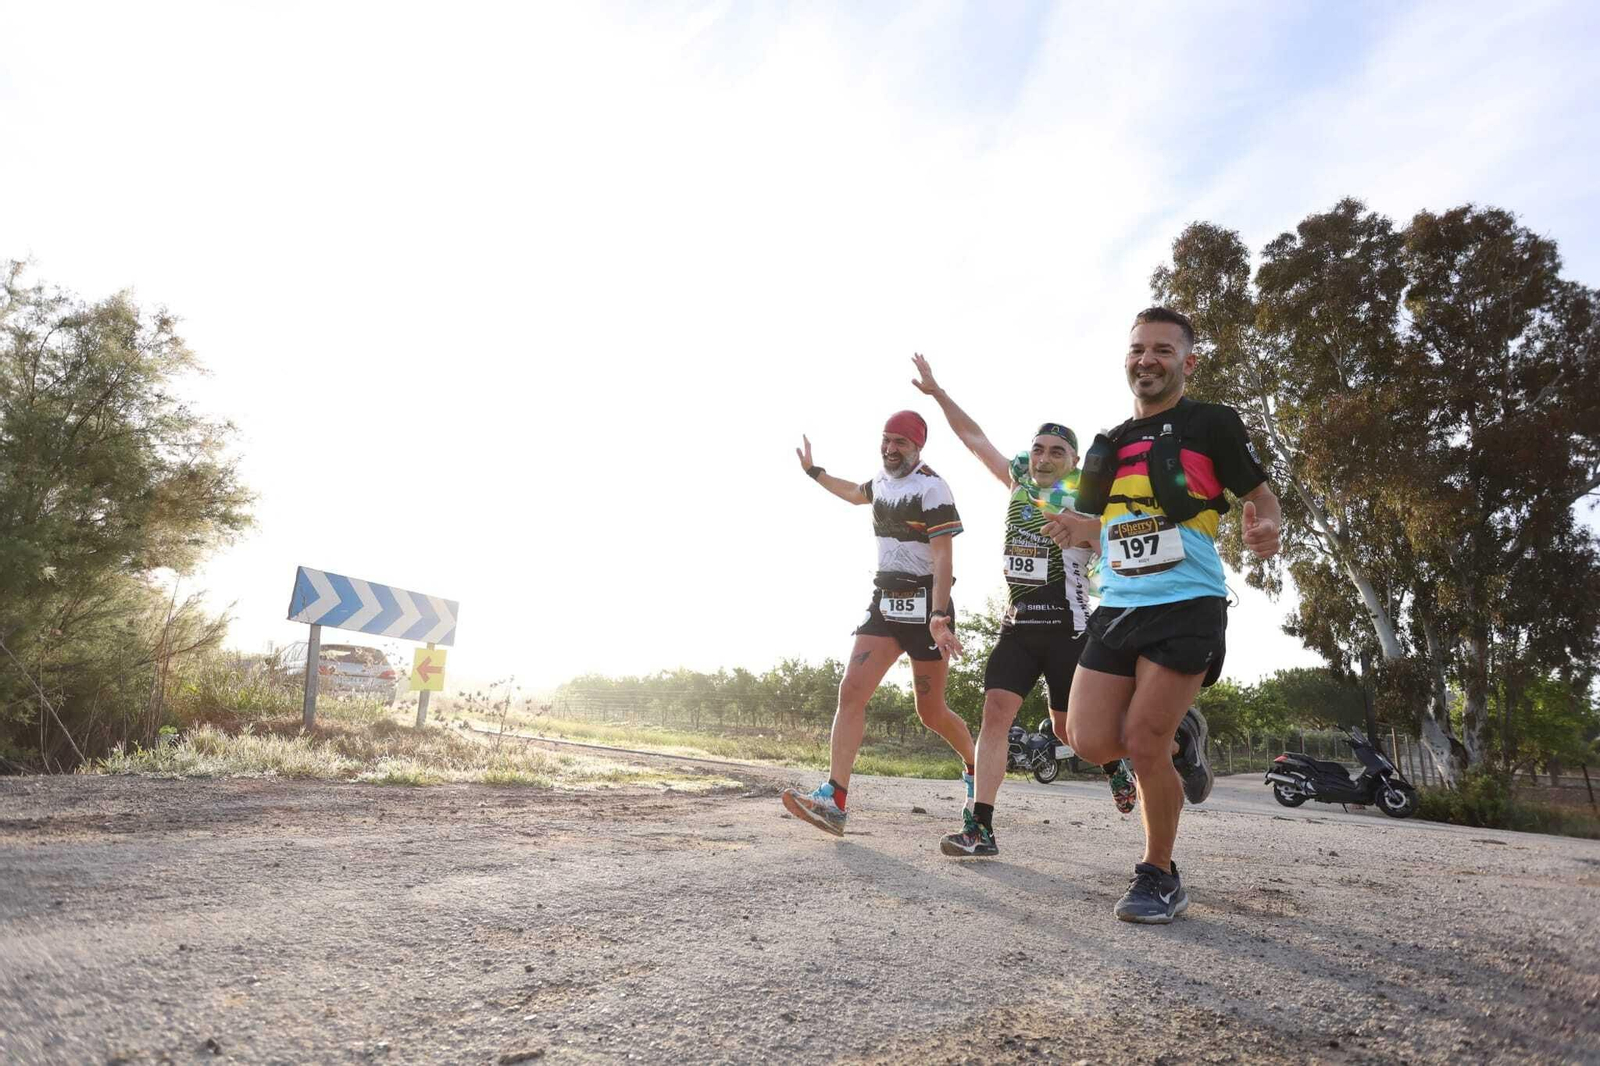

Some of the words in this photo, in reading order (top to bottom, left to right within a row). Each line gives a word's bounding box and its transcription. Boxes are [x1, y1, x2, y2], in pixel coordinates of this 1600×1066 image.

[1119, 534, 1160, 560] 197
[1009, 557, 1034, 573] 198
[888, 599, 915, 612] 185
